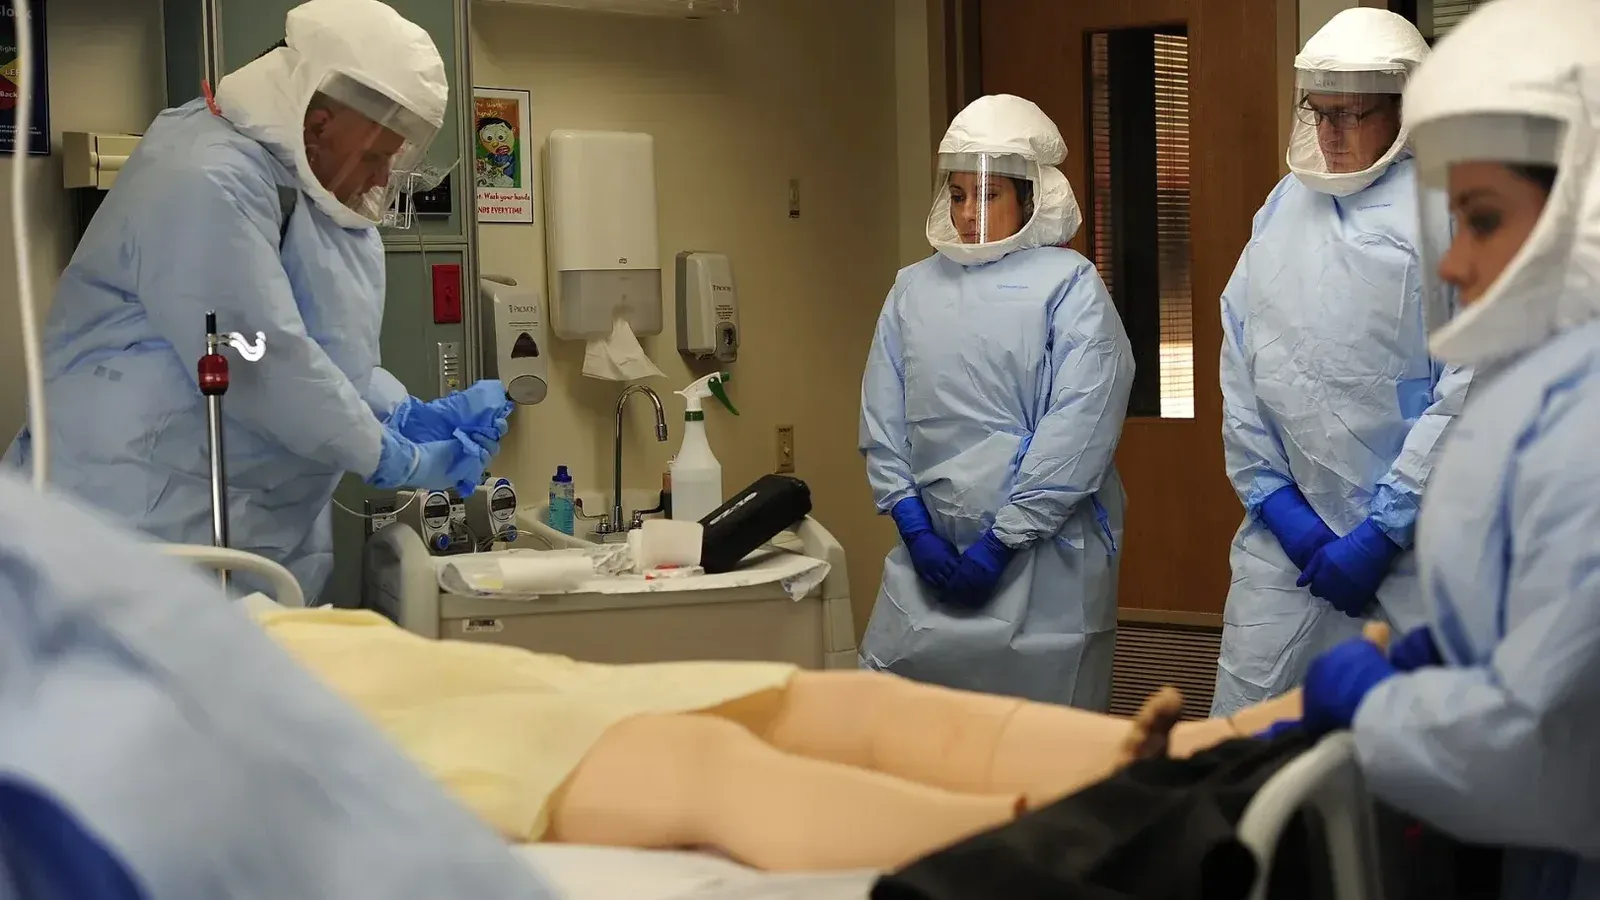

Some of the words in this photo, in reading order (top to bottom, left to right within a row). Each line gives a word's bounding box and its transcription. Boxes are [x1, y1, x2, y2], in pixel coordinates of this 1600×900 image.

[484, 192, 500, 200] Wash
[514, 193, 530, 201] hands
[491, 206, 523, 215] EVERYTIME
